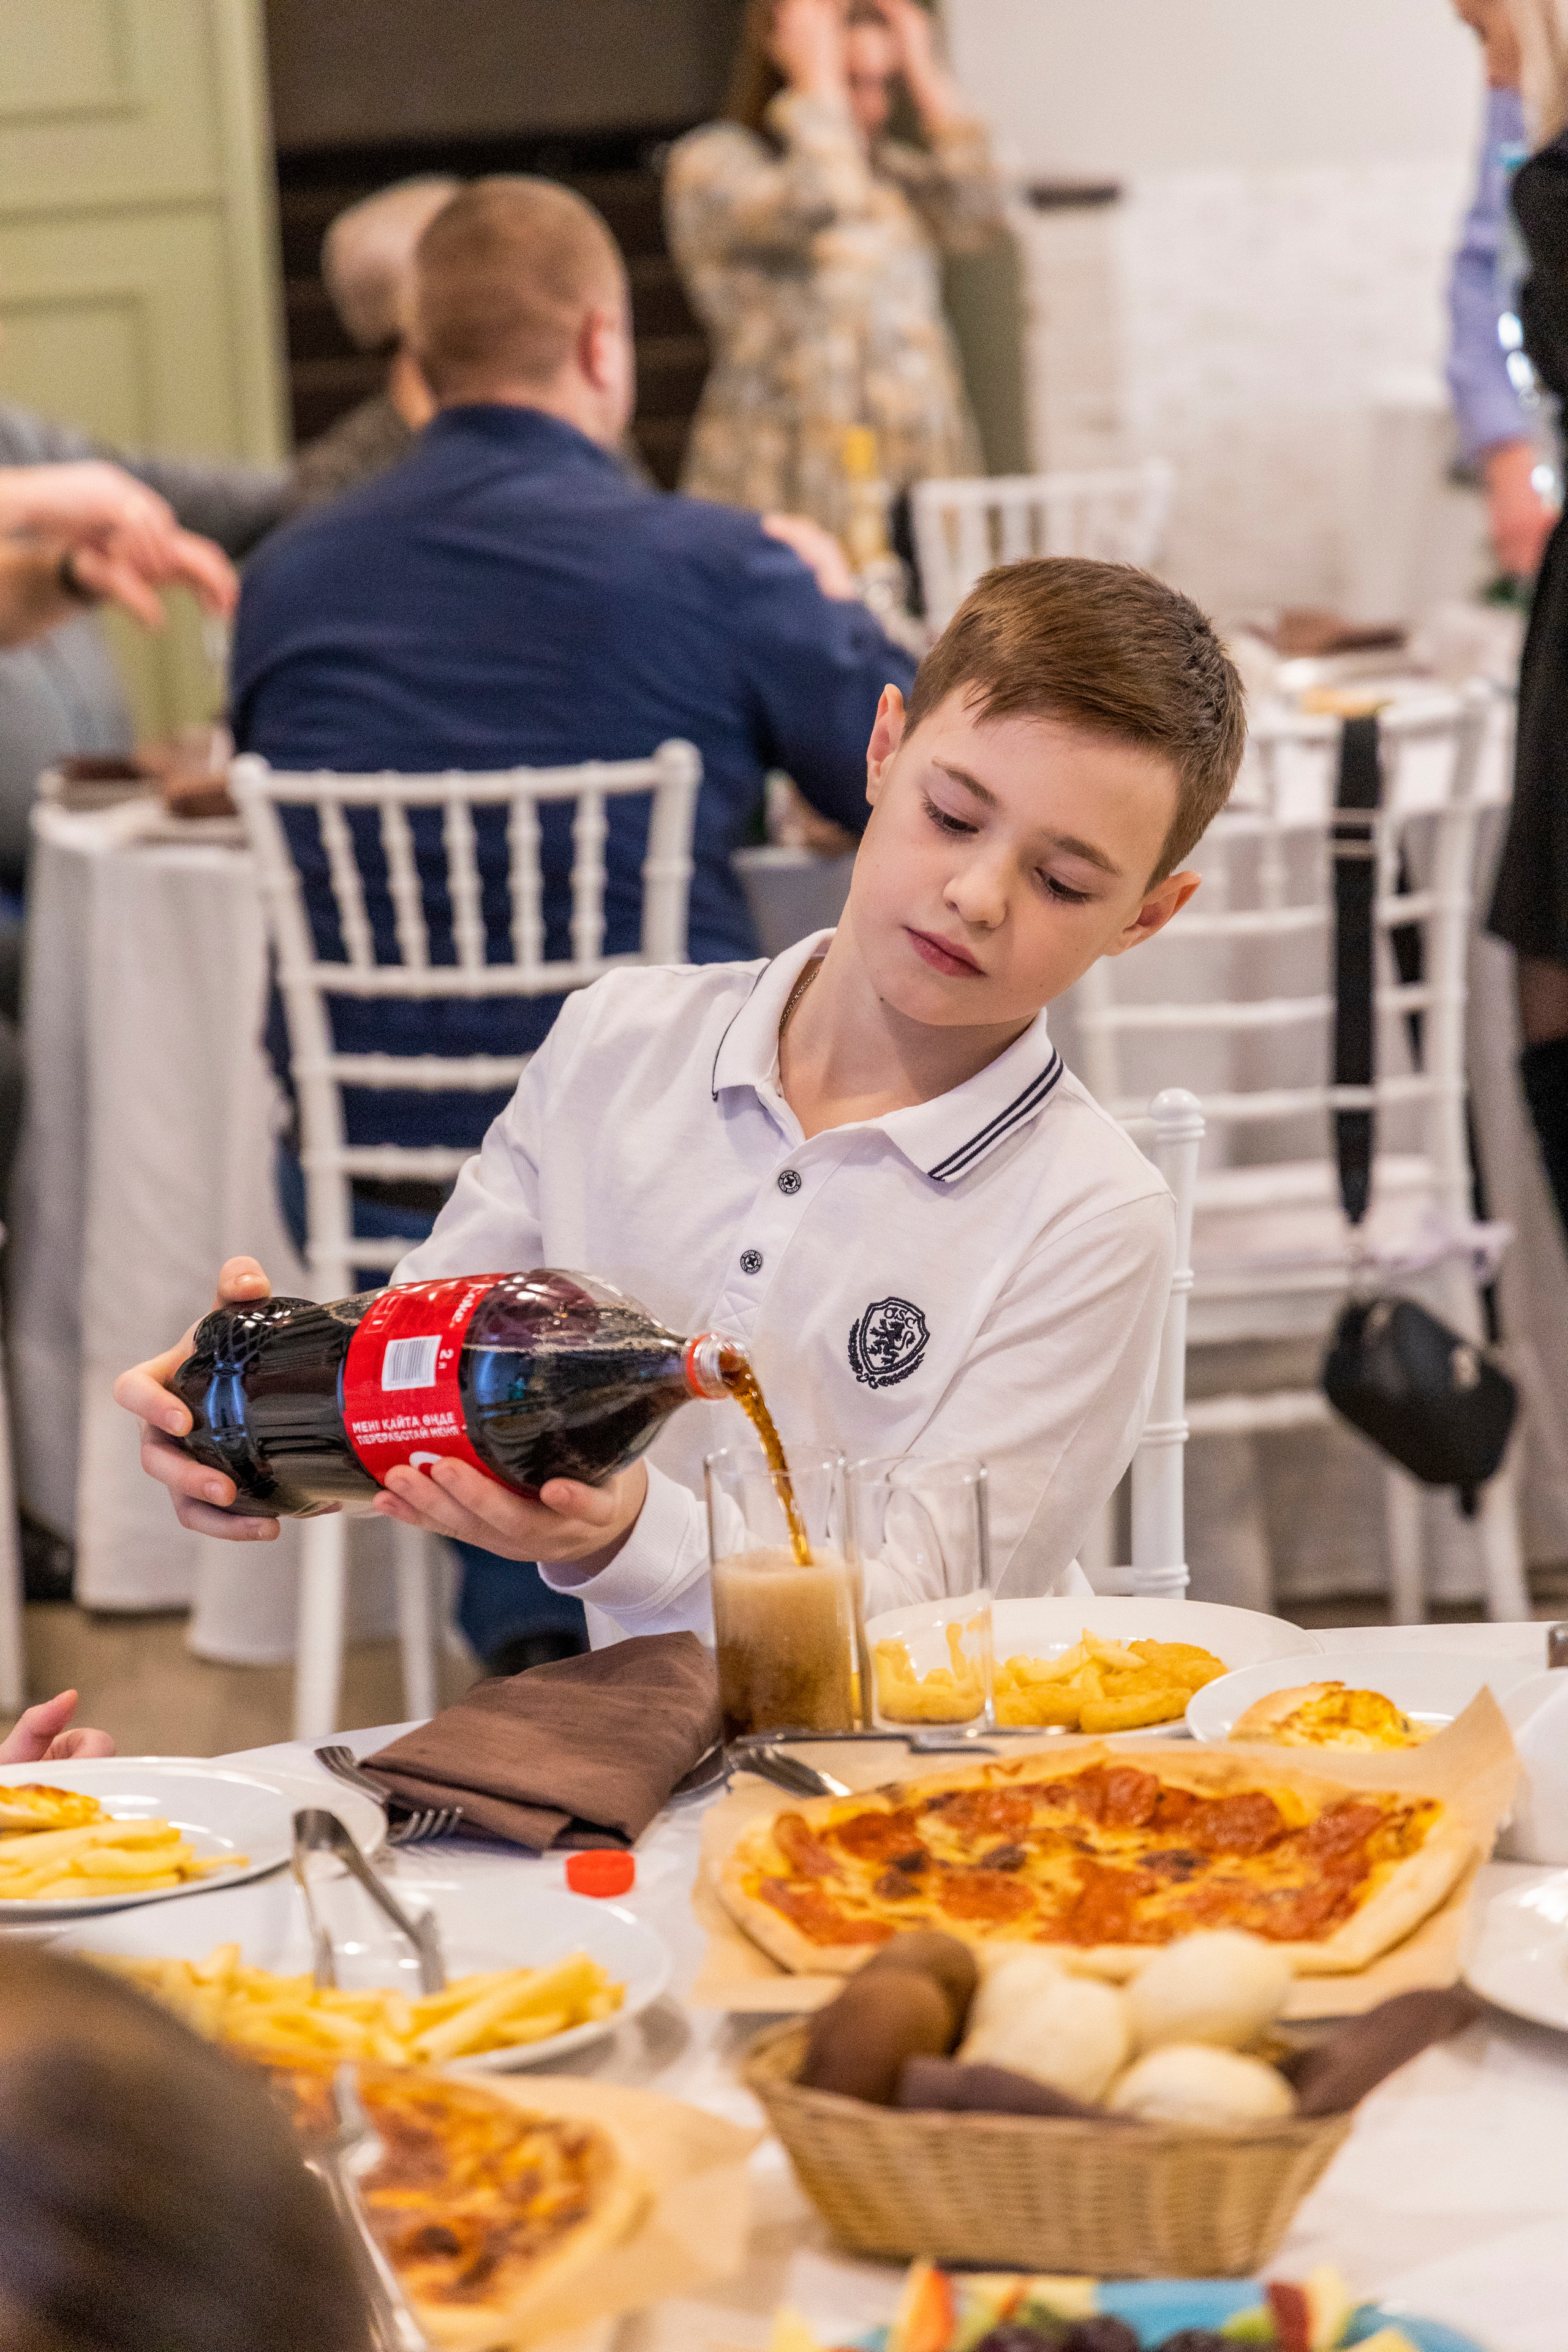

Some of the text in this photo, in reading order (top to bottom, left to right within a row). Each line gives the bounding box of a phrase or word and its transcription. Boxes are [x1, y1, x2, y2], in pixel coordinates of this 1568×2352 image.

[439, 1349, 454, 1360] 2
[352, 1420, 381, 1434] МЕНІ
[355, 1425, 459, 1446] ПЕРЕРАБОТАЙ МЕНЯ
